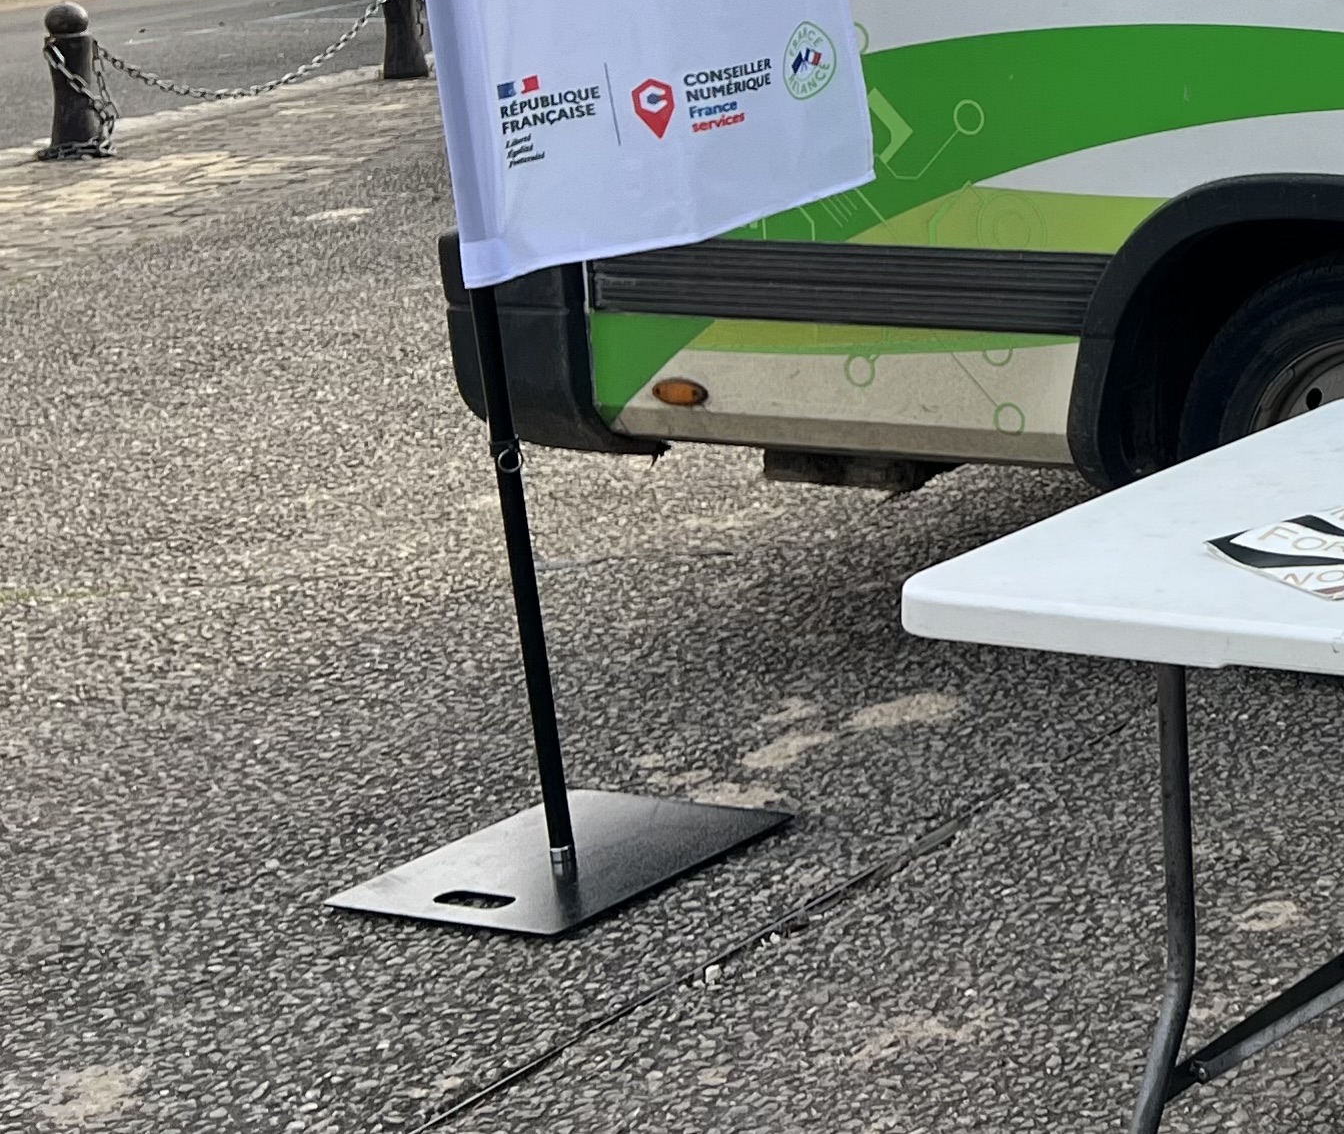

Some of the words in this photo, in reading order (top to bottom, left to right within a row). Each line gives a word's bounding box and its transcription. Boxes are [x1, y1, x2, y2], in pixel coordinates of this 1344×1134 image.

[683, 58, 773, 87] CONSEILLER
[685, 72, 772, 103] NUMÉRIQUE
[500, 85, 601, 119] RÉPUBLIQUE
[688, 100, 738, 119] France
[502, 102, 596, 135] FRANÇAISE
[691, 111, 746, 133] services
